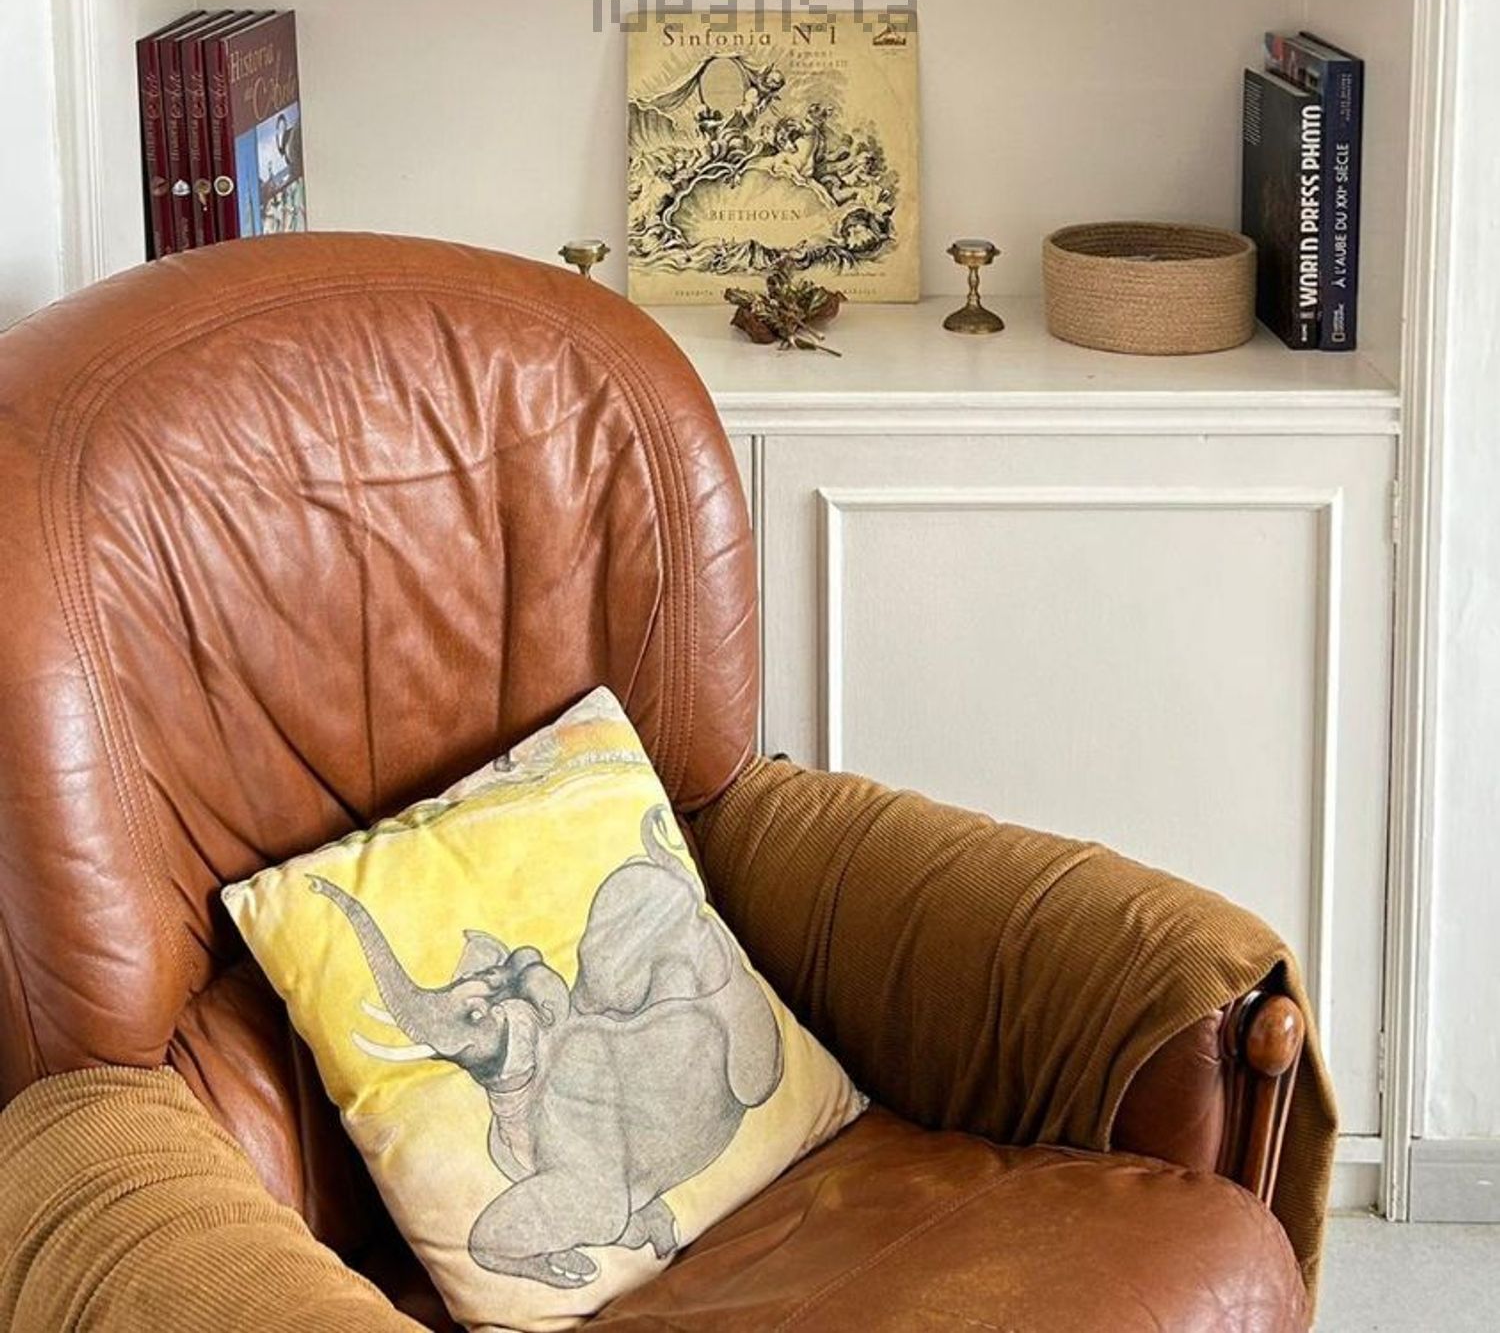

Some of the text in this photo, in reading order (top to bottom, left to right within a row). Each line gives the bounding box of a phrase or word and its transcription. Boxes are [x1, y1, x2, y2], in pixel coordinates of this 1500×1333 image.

[662, 25, 771, 47] Sinfonia
[1300, 104, 1322, 171] PHOTO
[1335, 142, 1350, 182] SIÈCLE
[709, 208, 802, 222] BEETHOVEN
[1300, 173, 1321, 233] PRESS
[1334, 211, 1348, 230] DU
[1300, 236, 1321, 308] WORLD
[1332, 233, 1348, 275] L'AUBE
[1332, 278, 1346, 288] À
